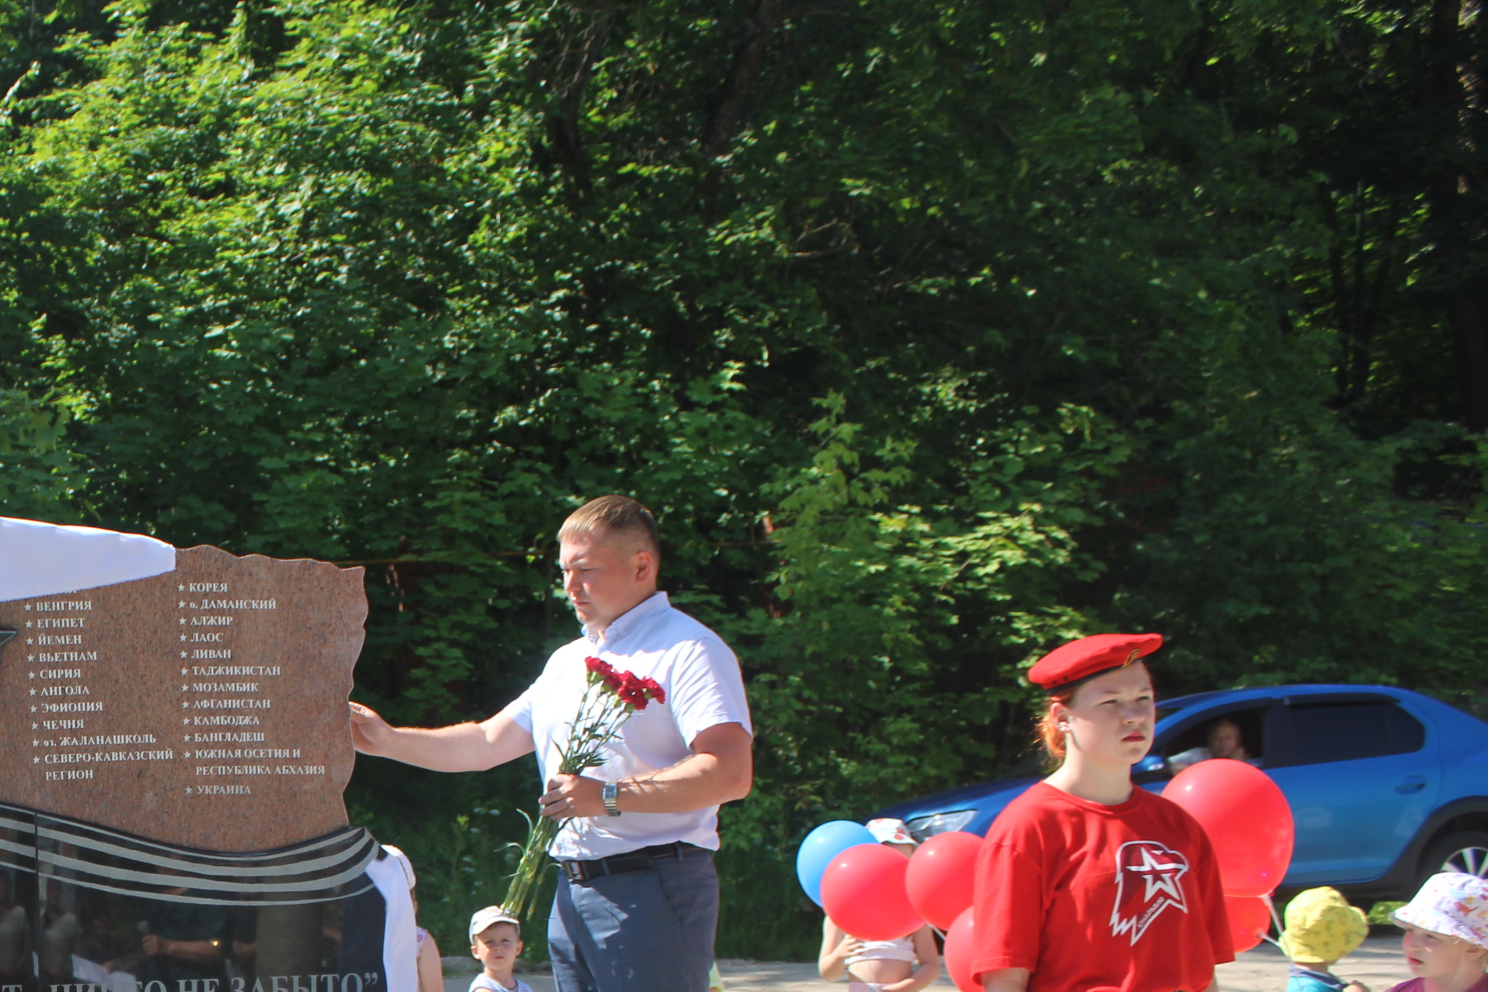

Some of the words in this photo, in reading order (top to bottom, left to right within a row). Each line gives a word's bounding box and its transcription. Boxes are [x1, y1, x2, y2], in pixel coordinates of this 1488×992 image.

[189, 582, 228, 593] КОРЕЯ
[36, 600, 92, 612] ВЕНГРИЯ
[189, 600, 198, 609] о.
[200, 598, 277, 610] ДАМАНСКИЙ
[37, 617, 86, 629] ЕГИПЕТ
[190, 616, 233, 626] АЛЖИР
[38, 633, 82, 646] ЙЕМЕН
[190, 632, 224, 642] ЛАОС
[38, 651, 98, 663] ВЬЕТНАМ
[190, 649, 232, 659] ЛИВАН
[39, 668, 82, 680] СИРИЯ
[192, 666, 281, 677] ТАДЖИКИСТАН
[40, 685, 90, 697] АНГОЛА
[192, 682, 259, 693] МОЗАМБИК
[40, 701, 104, 714] ЭФИОПИЯ
[193, 699, 271, 709] АФГАНИСТАН
[42, 719, 85, 730] ЧЕЧНЯ
[193, 716, 260, 727] КАМБОДЖА
[59, 734, 157, 747] ЖАЛАНАШКОЛЬ
[194, 732, 265, 743] БАНГЛАДЕШ
[44, 748, 174, 764] СЕВЕРО-КАВКАЗСКИЙ
[195, 749, 242, 759] ЮЖНАЯ
[244, 749, 290, 759] ОСЕТИЯ
[292, 749, 301, 759] И
[45, 769, 94, 781] РЕГИОН
[195, 765, 271, 776] РЕСПУБЛИКА
[274, 765, 325, 775] АБХАЗИЯ
[196, 785, 252, 796] УКРАИНА
